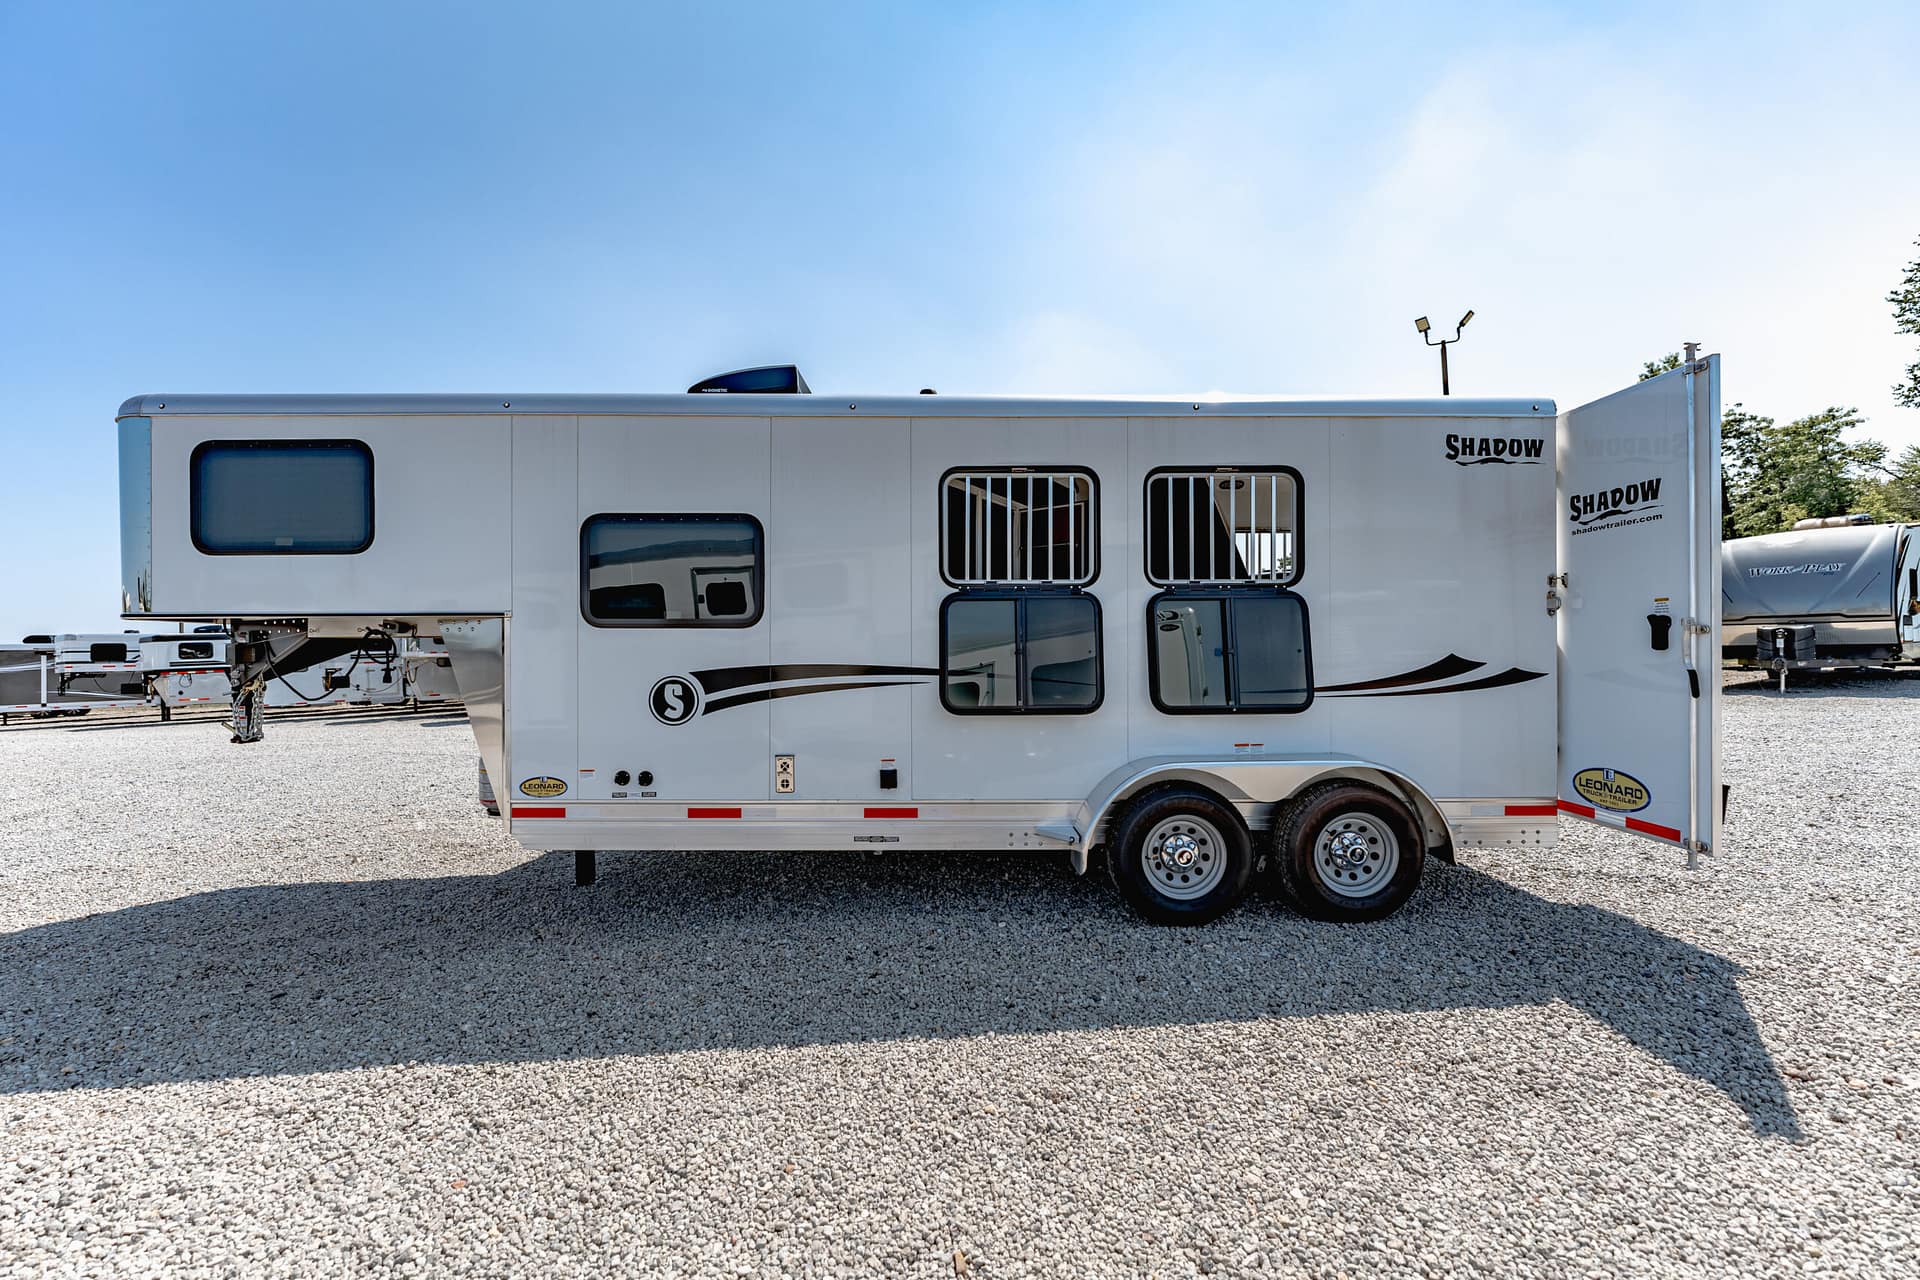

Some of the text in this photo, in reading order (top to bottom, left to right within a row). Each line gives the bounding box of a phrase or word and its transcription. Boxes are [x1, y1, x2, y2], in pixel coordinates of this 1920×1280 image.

[1445, 433, 1545, 460] SHADOW
[1569, 477, 1662, 522] SHADOW
[1571, 512, 1663, 536] shadowtrailer.com
[664, 683, 685, 719] S
[1579, 776, 1643, 801] LEONARD
[1583, 788, 1603, 797] TRUCK
